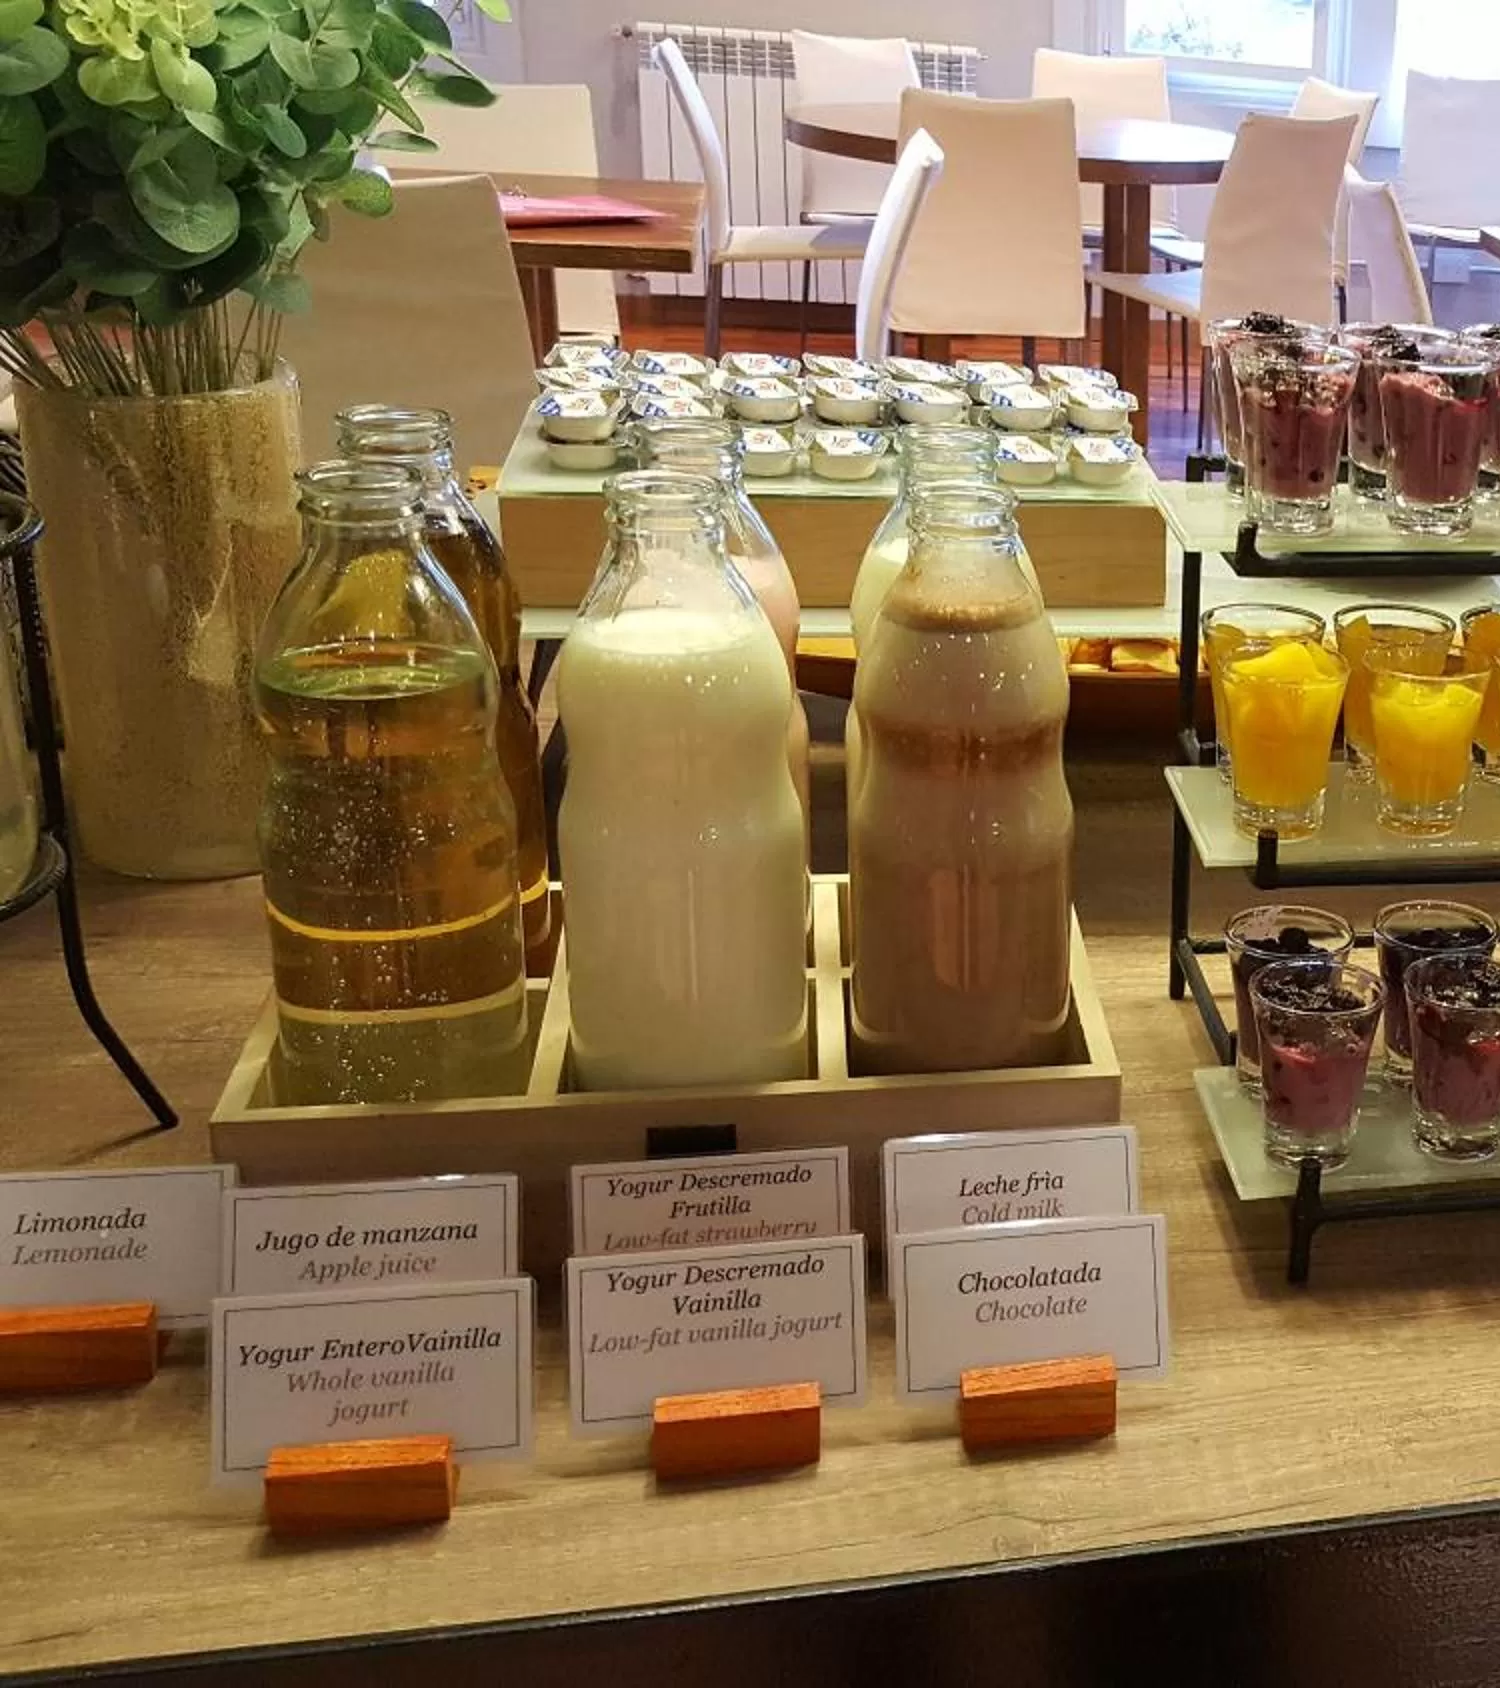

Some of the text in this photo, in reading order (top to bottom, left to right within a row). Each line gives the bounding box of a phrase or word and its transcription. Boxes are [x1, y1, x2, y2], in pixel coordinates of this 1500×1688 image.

[607, 1164, 812, 1198] Yogur Descremado
[959, 1174, 1020, 1197] Leche
[668, 1196, 752, 1218] Frutilla
[962, 1197, 1064, 1225] Cold milk
[14, 1209, 146, 1235] Limonada
[12, 1238, 148, 1266] Lemonade
[255, 1222, 478, 1254] Jugo de manzana
[603, 1226, 690, 1251] Low-fat
[298, 1254, 437, 1284] Apple juice
[607, 1255, 824, 1294] Yogur Descremado
[958, 1262, 1102, 1294] Chocolatada
[672, 1289, 761, 1316] Vainilla
[975, 1296, 1087, 1323] Chocolate
[590, 1312, 842, 1353] Low-fat vanilla jogurt
[238, 1344, 315, 1369] Yogur
[286, 1362, 455, 1393] Whole vanilla
[327, 1399, 410, 1427] jogurt
